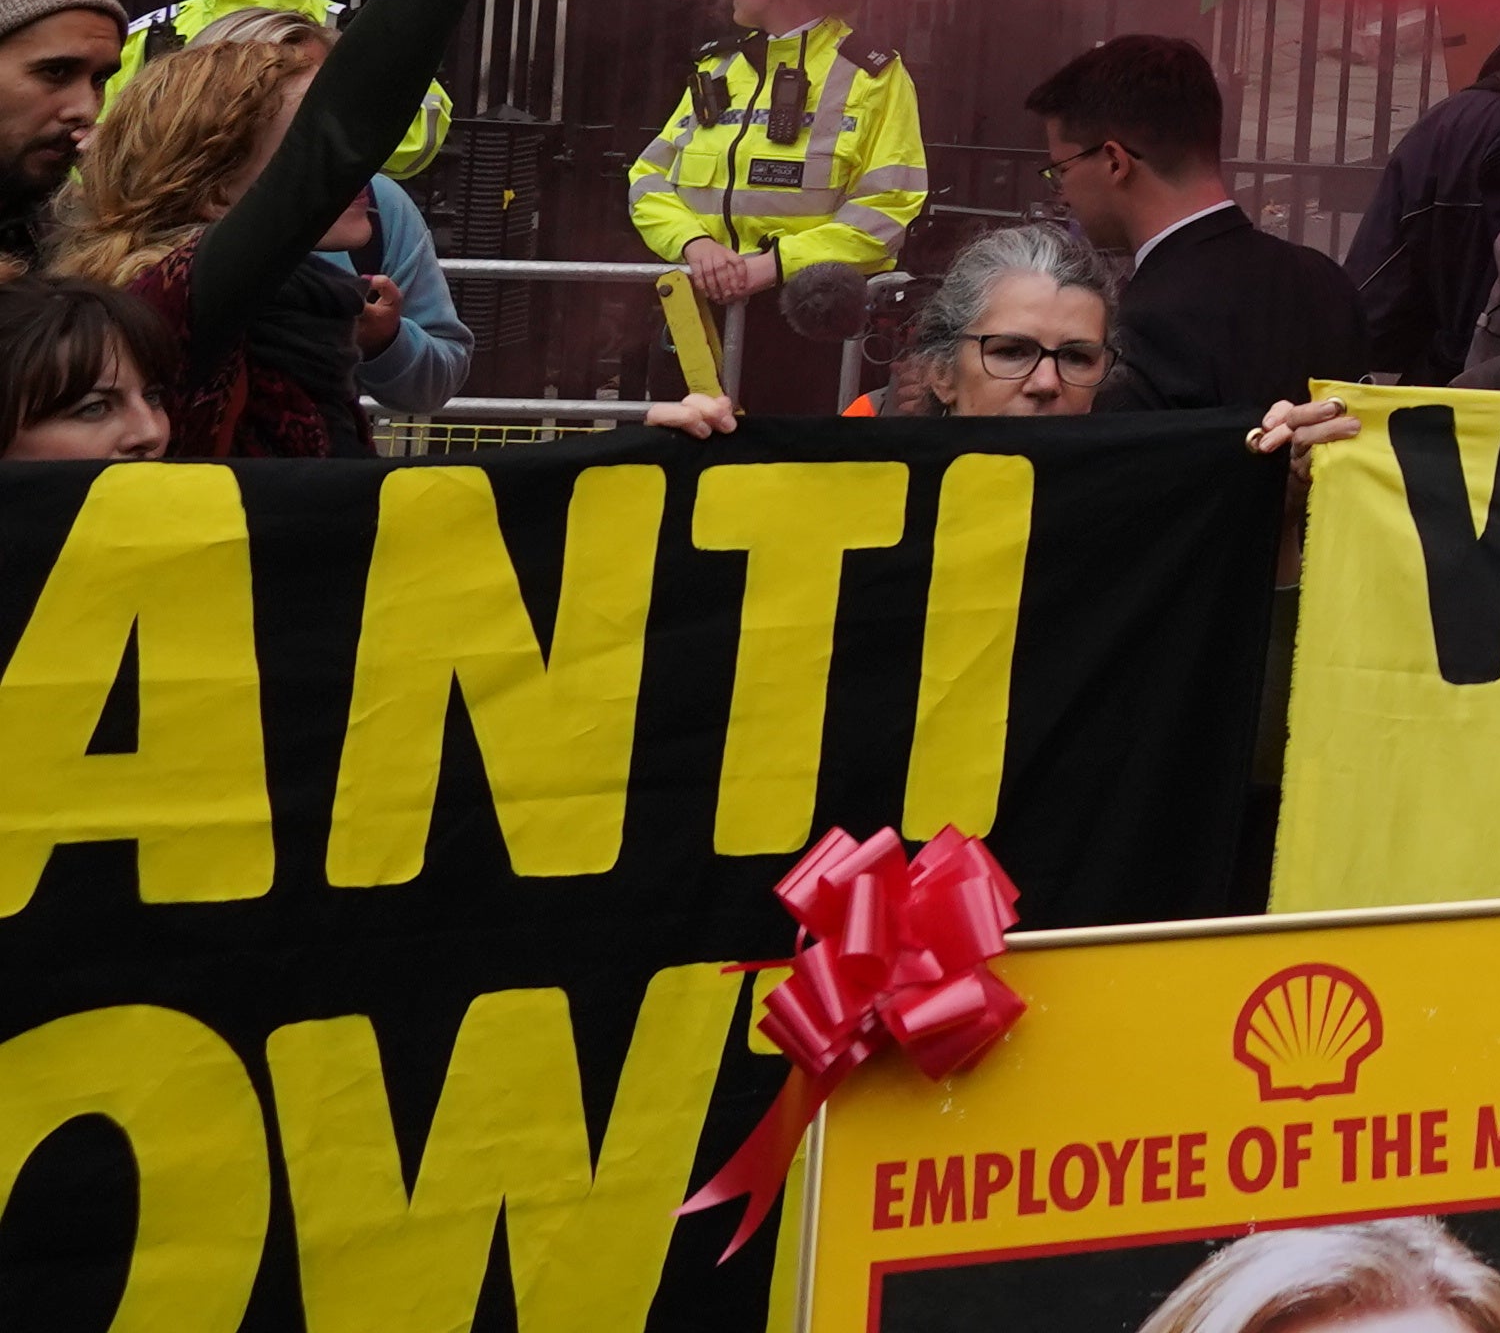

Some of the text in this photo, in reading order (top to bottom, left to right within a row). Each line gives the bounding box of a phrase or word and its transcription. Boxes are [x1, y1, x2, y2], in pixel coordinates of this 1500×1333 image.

[0, 453, 1035, 919] ANTI
[872, 1132, 1208, 1231] EMPLOYEE
[1227, 1122, 1314, 1194] OF
[1332, 1110, 1449, 1183] THE
